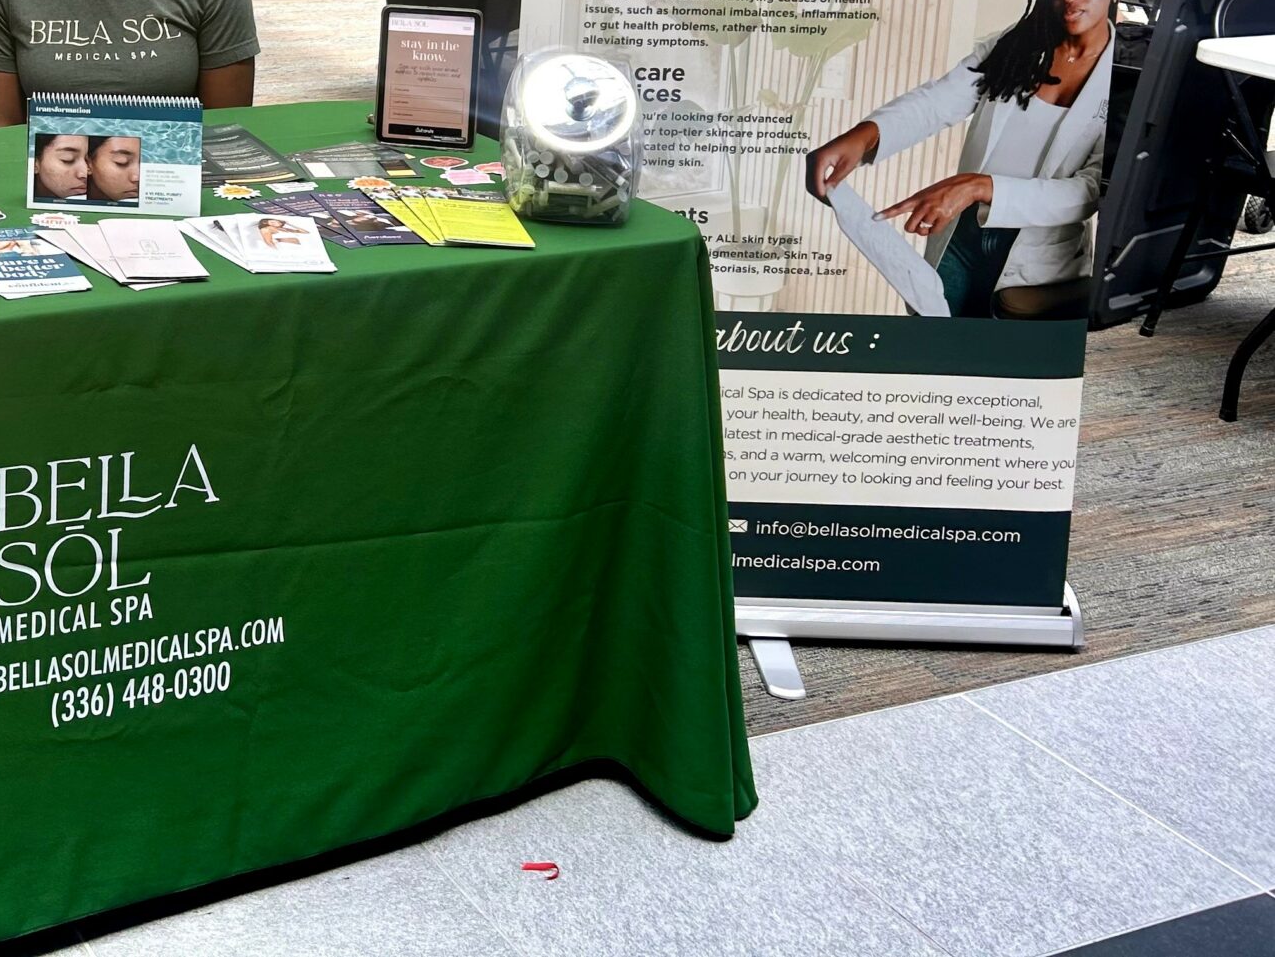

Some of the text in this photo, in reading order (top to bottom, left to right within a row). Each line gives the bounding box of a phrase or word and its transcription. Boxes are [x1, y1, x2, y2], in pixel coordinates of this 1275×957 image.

[585, 4, 622, 15] issues,
[627, 6, 652, 14] such
[672, 6, 725, 16] hormonal
[730, 8, 797, 19] imbalances,
[802, 9, 879, 21] inflammation,
[30, 20, 113, 47] BELLA
[600, 21, 619, 30] gut
[623, 21, 658, 30] health
[662, 22, 718, 32] problems,
[723, 23, 758, 32] rather
[761, 24, 786, 33] than
[790, 25, 827, 35] simply
[400, 39, 460, 52] stay in the
[583, 35, 708, 47] alleviating symptoms.
[54, 50, 158, 61] MEDICAL SPA
[412, 50, 447, 62] know.
[36, 106, 91, 115] transformation
[41, 257, 57, 265] a
[0, 263, 65, 273] better
[813, 332, 853, 354] us
[757, 521, 1020, 543] info@bellasolmedicalspa.com
[110, 593, 153, 625] SPA
[51, 661, 232, 728] (336) 448-0300
